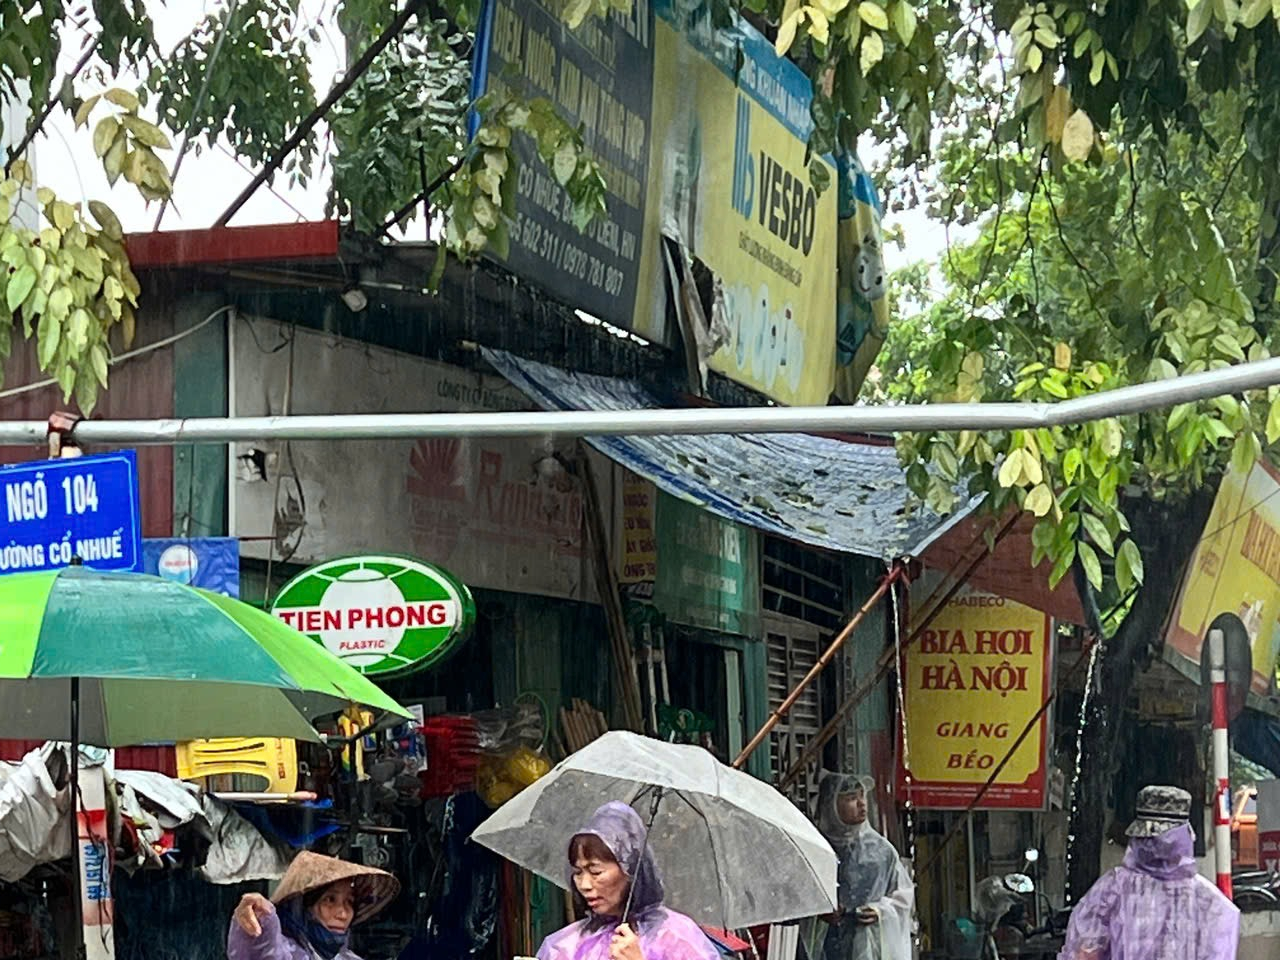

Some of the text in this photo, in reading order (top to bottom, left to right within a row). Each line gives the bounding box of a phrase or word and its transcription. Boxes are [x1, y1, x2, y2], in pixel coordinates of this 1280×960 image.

[759, 150, 816, 257] VESBO
[6, 472, 98, 522] NGÕ 104
[49, 530, 72, 564] CỔ
[76, 527, 123, 562] NHUẾ
[948, 596, 1006, 608] HABECO
[279, 603, 446, 632] TIEN PHONG
[339, 639, 386, 651] PLASTIC
[920, 628, 1035, 656] BIA HƠI
[920, 658, 1028, 698] HÀ NỘI
[936, 721, 1009, 739] GIANG
[946, 748, 995, 770] BÉO
